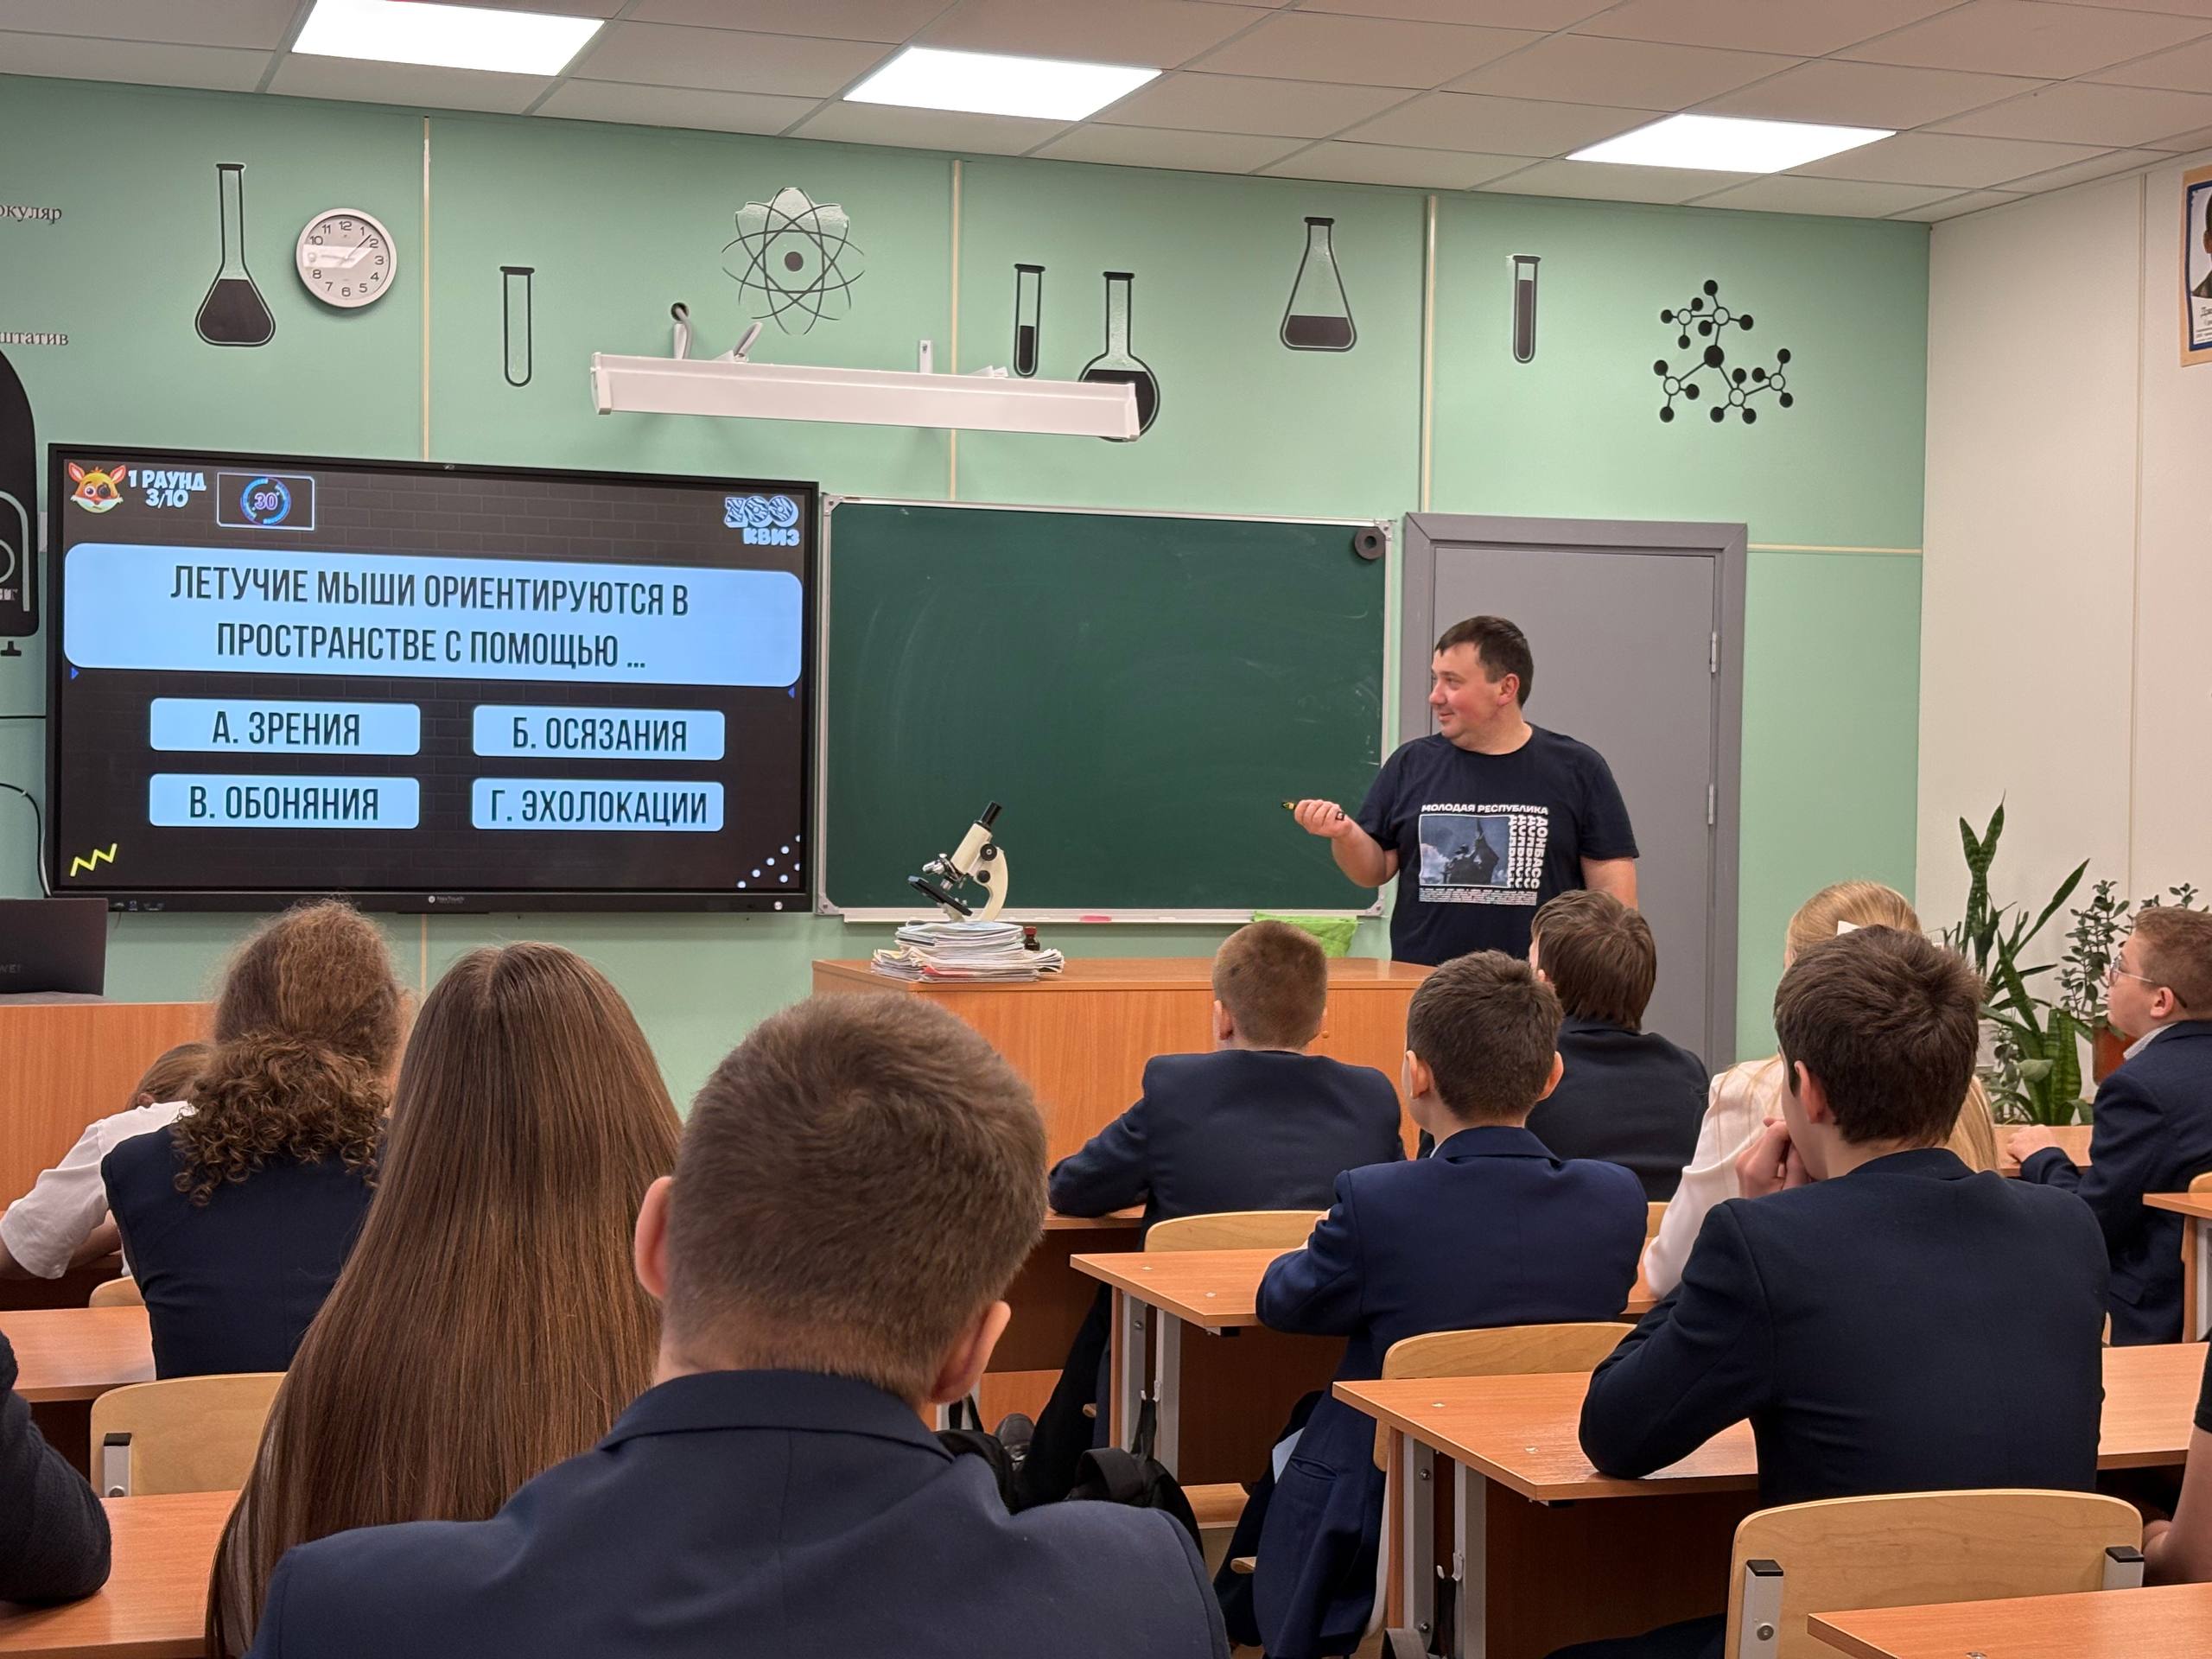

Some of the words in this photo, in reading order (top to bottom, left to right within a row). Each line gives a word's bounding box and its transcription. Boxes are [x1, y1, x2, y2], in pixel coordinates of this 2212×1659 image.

[322, 224, 331, 234] 11
[339, 220, 352, 231] 12
[359, 226, 365, 236] 1
[309, 235, 324, 245] 10
[369, 238, 379, 249] 2
[374, 255, 385, 265] 3
[312, 269, 321, 279] 8
[370, 271, 379, 281] 4
[325, 281, 334, 291] 7
[341, 286, 351, 297] 6
[359, 283, 368, 293] 5
[128, 469, 137, 487] 1
[142, 470, 207, 492] РАУНД
[145, 489, 189, 509] 3/10
[254, 493, 278, 510] 30
[743, 528, 800, 546] КВИЗ
[171, 565, 308, 603] ЛЕТУЧИЕ
[317, 571, 415, 607] МЫШИ
[424, 575, 664, 615] ОРИЕНТИРУЮТСЯ
[672, 584, 689, 616] В
[217, 623, 436, 661] ПРОСТРАНСТВЕ
[445, 630, 461, 663] С
[470, 631, 618, 669] ПОМОЩЬЮ
[212, 711, 238, 744] А.
[249, 711, 359, 747] ЗРЕНИЯ
[513, 716, 537, 749] Б.
[546, 717, 687, 752] ОСЯЗАНИЯ
[189, 785, 215, 819] В.
[226, 786, 378, 820] ОБОНЯНИЯ
[491, 789, 512, 822] Г.
[522, 790, 707, 827] ЭХОЛОКАЦИИ
[1421, 804, 1476, 812] МОЛОДАЯ
[1477, 804, 1548, 815] РЕСПУБЛИКА
[1530, 816, 1548, 889] ДОНБАСС
